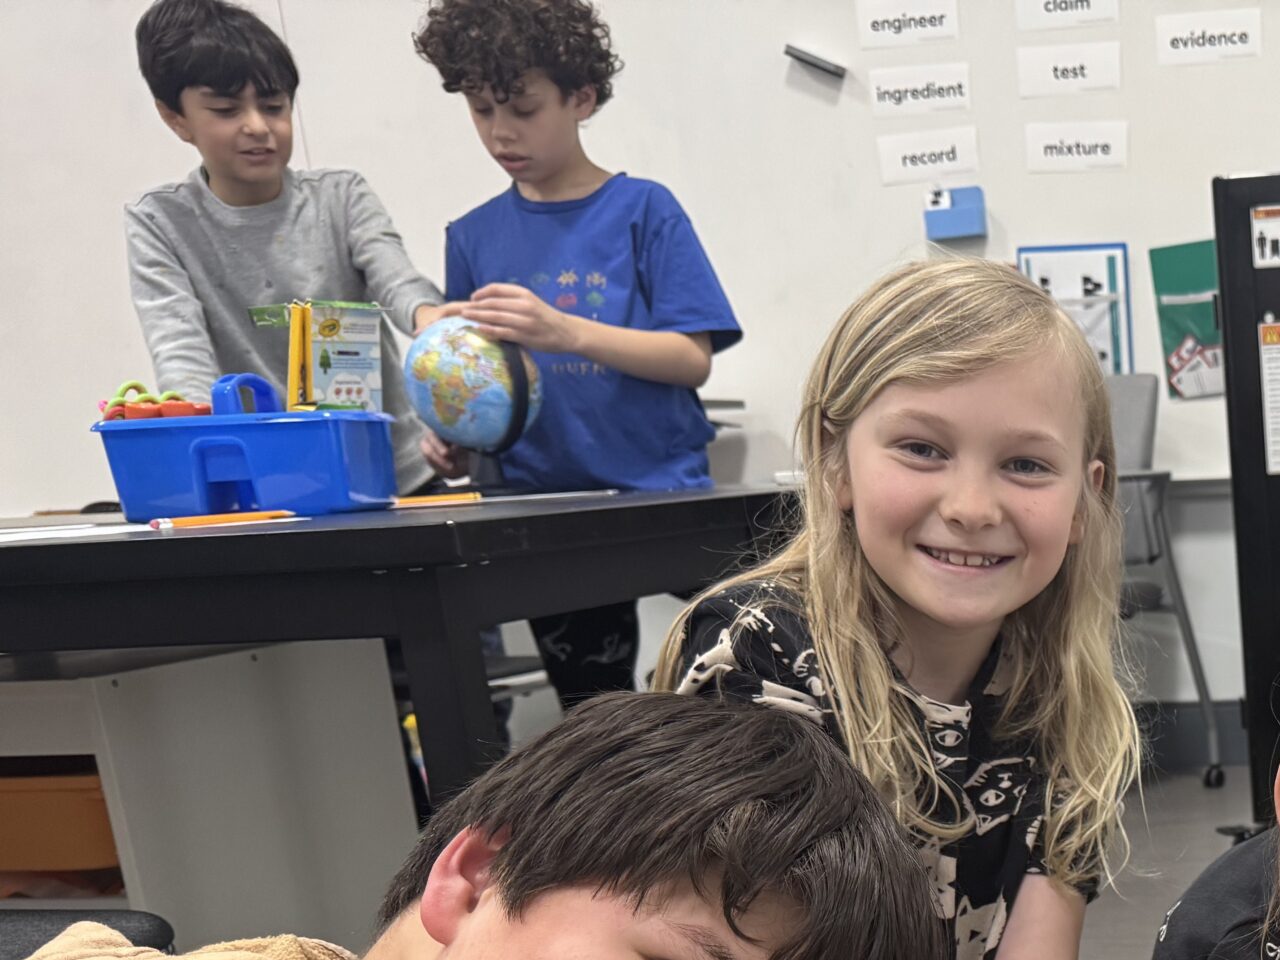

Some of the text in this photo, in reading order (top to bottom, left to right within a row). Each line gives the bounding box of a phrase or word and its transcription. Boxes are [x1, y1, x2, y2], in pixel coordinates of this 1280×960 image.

[1043, 0, 1091, 13] claim
[870, 13, 946, 34] engineer
[1169, 31, 1250, 50] evidence
[1052, 64, 1087, 80] test
[876, 81, 966, 106] ingredient
[901, 145, 958, 167] record
[1043, 139, 1112, 158] mixture
